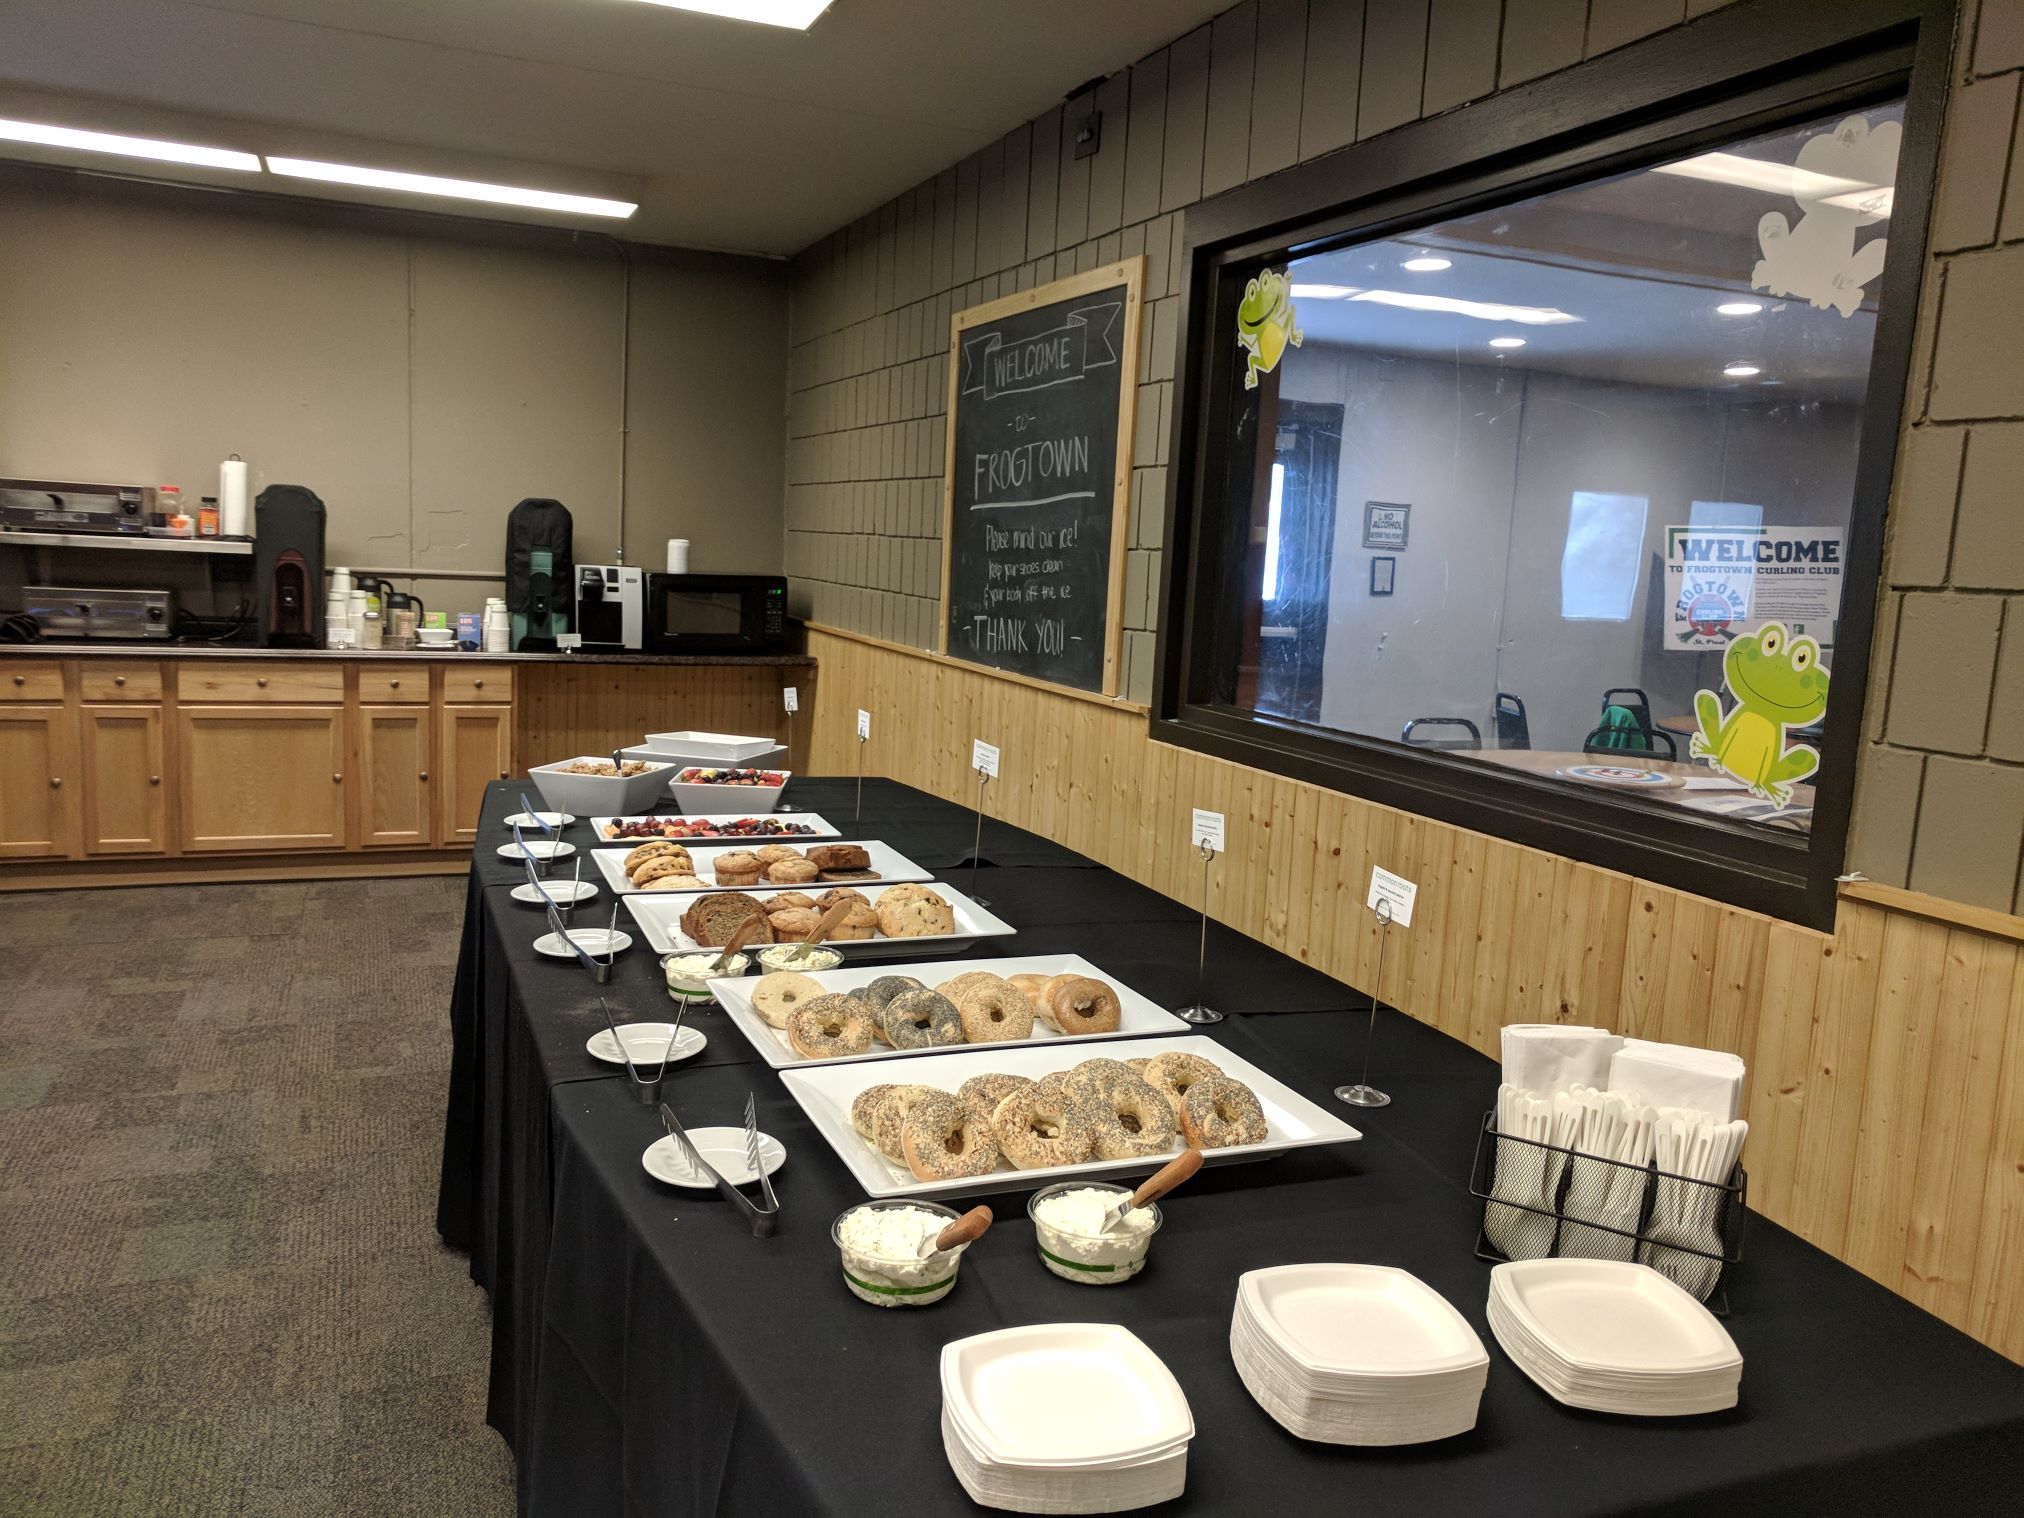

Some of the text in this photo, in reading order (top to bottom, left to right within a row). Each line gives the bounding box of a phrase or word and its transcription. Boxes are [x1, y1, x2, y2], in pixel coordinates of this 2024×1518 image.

[995, 338, 1071, 388] WELCOME
[974, 435, 1088, 501] FROGTOWN
[1372, 521, 1402, 530] ALCOHOL
[1384, 512, 1394, 520] NO
[986, 524, 1010, 552] Please
[1013, 525, 1034, 549] mind
[1040, 530, 1056, 549] our
[1678, 539, 1840, 563] WELCOME
[1020, 562, 1040, 575] shoes
[1042, 559, 1064, 573] clean
[1669, 565, 1840, 575] TO FROGTOWN CURLING CLUB
[1025, 585, 1040, 602] off
[1041, 585, 1056, 600] the
[1675, 581, 1745, 622] FROGTOWN
